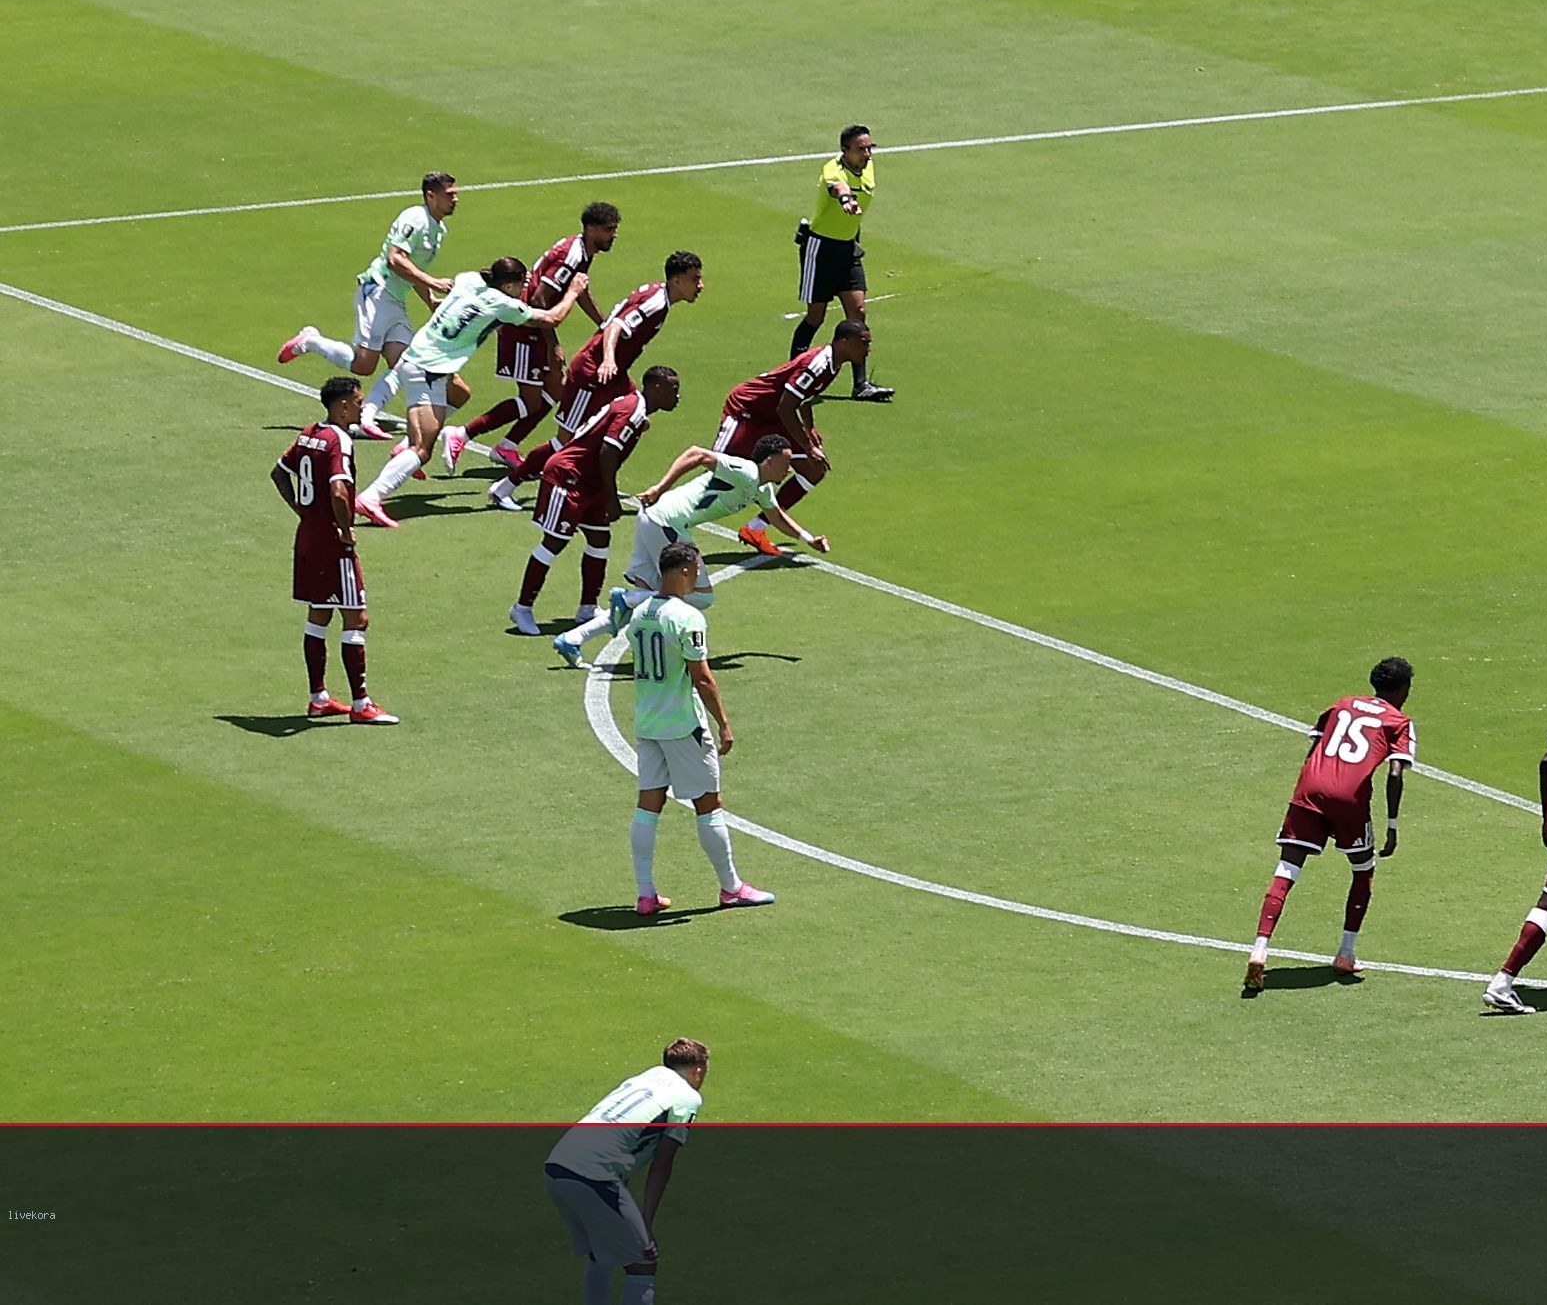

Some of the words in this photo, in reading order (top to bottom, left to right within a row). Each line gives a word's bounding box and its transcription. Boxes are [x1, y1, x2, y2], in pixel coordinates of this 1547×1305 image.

[299, 455, 315, 506] 8
[634, 628, 665, 681] 10
[1324, 709, 1382, 764] 15
